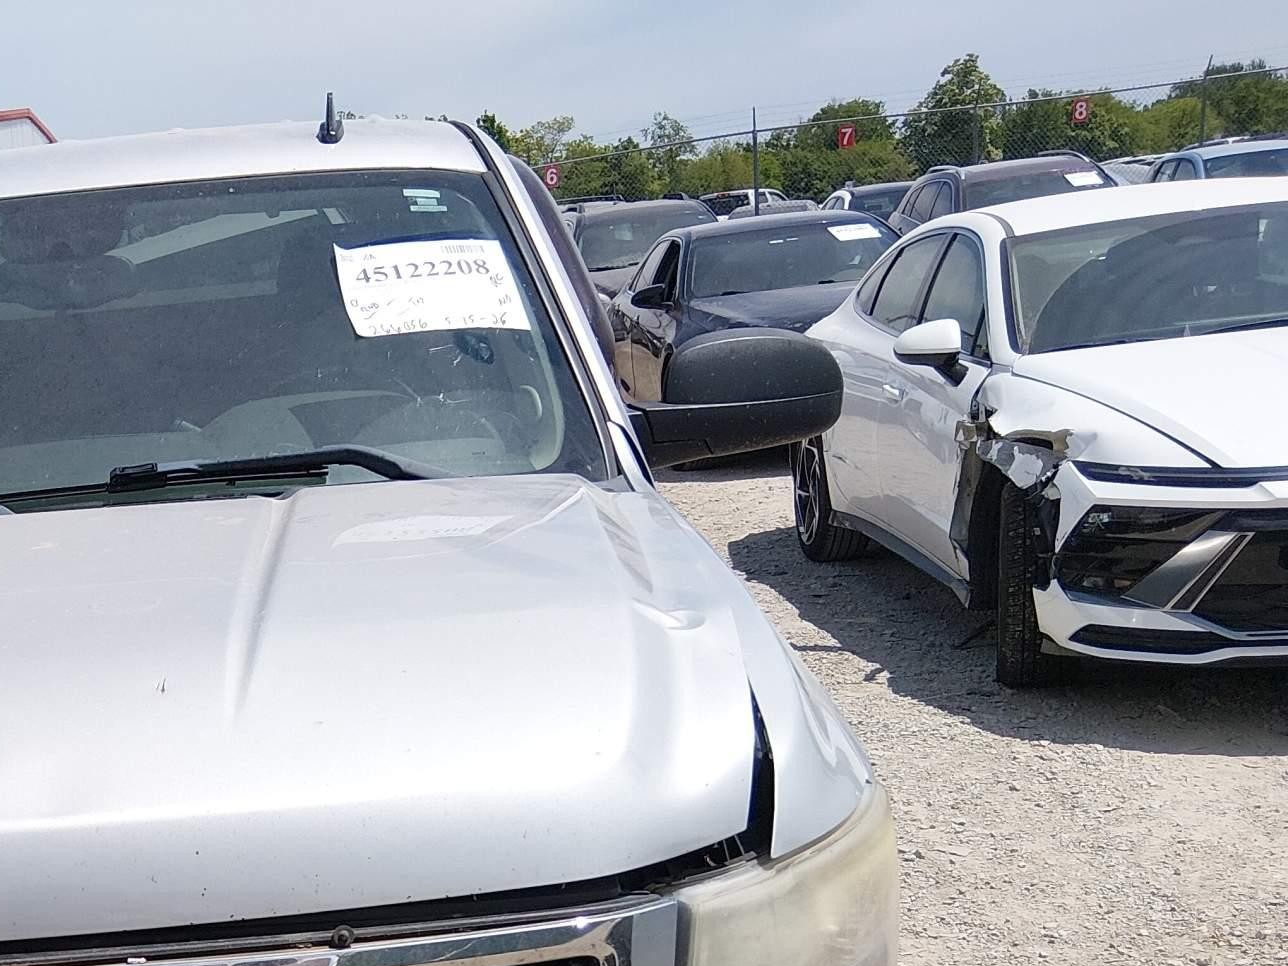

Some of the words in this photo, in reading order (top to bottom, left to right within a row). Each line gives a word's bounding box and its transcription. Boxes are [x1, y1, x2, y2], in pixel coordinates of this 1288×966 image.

[1074, 101, 1086, 119] 8
[840, 127, 853, 145] 7
[546, 168, 557, 185] 6
[355, 257, 490, 284] 45122208
